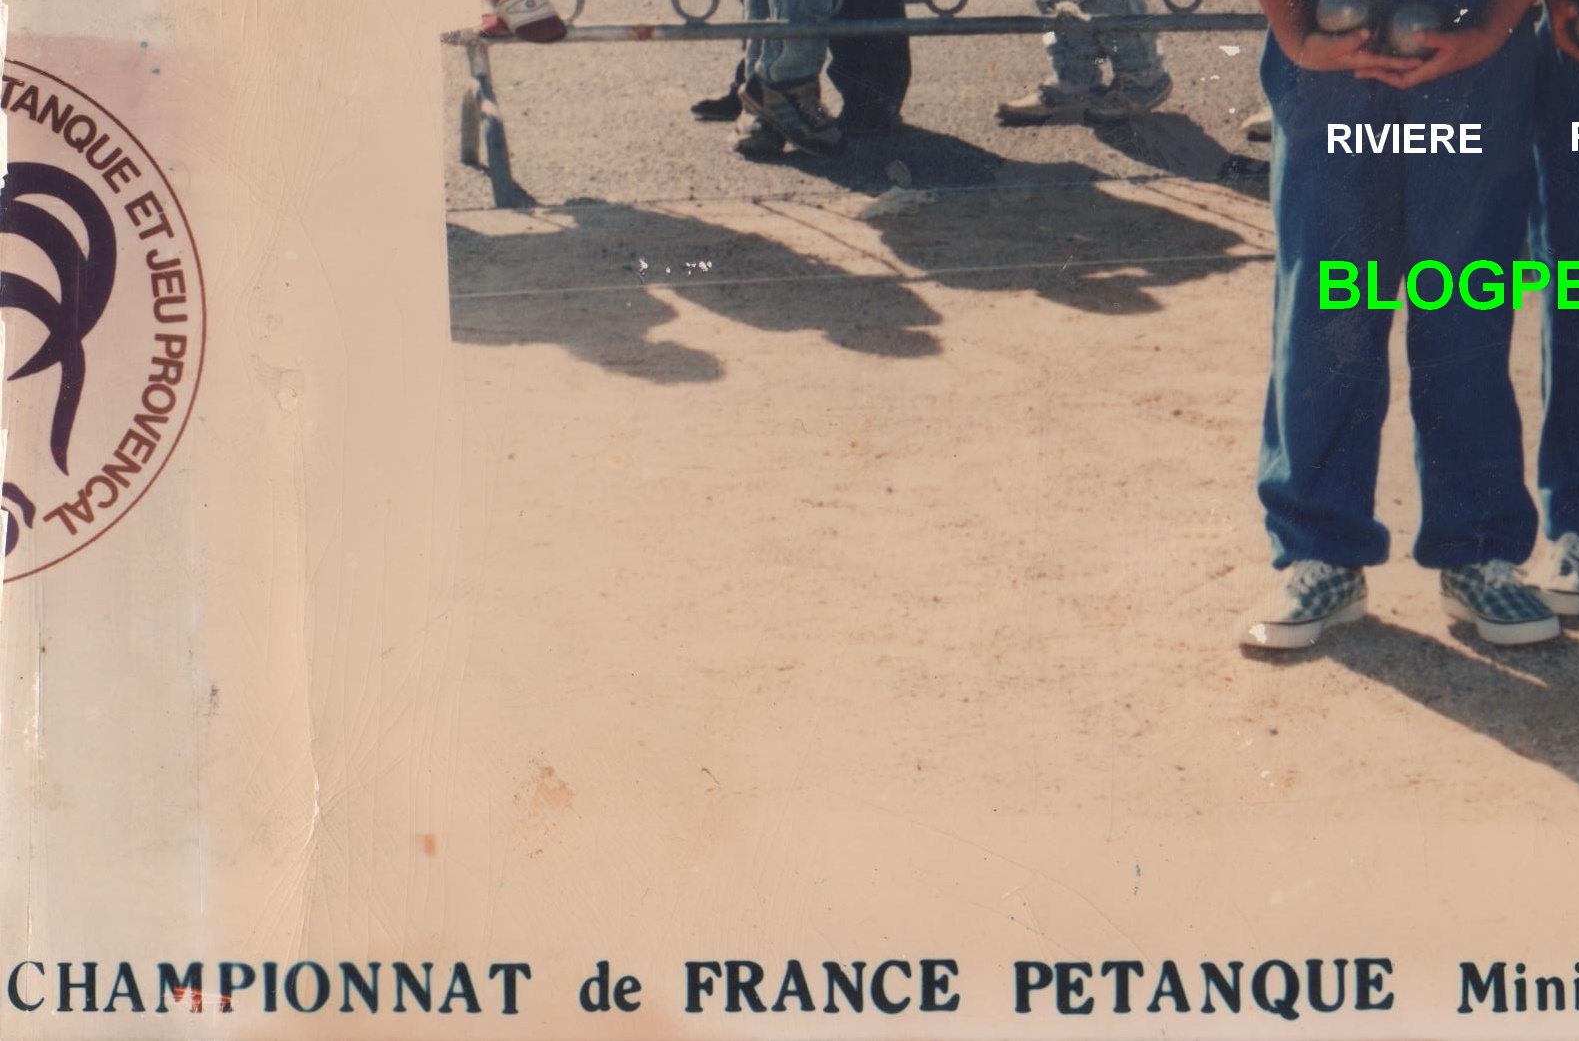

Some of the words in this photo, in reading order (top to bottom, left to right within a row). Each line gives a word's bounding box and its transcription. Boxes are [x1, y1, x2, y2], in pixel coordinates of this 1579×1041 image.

[124, 190, 175, 242] ET
[146, 248, 188, 324] JEU
[43, 332, 188, 535] PROVENCAL
